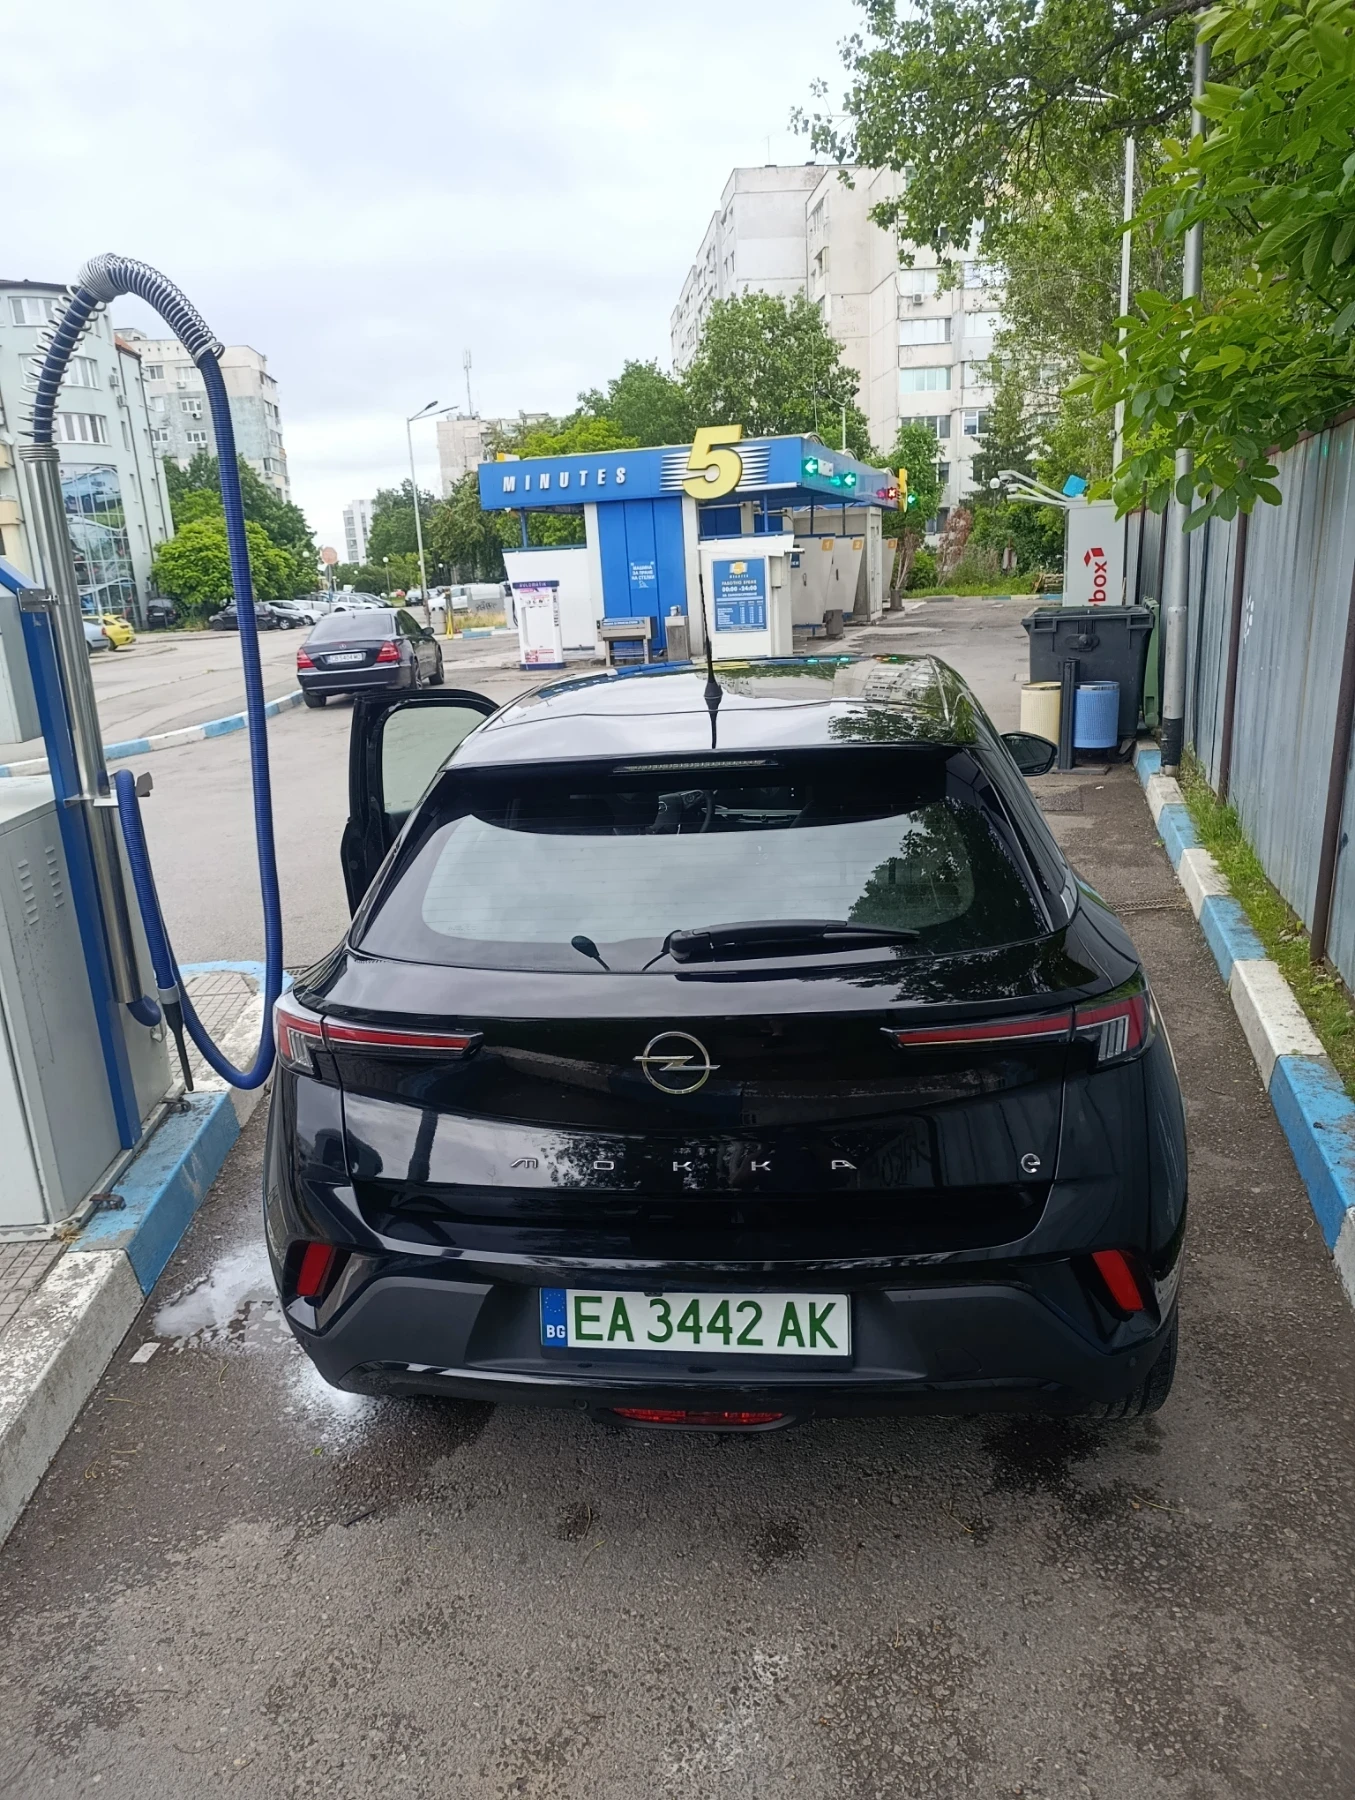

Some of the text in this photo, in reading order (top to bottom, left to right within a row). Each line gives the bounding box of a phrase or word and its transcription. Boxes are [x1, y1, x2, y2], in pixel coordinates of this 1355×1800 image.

[502, 466, 627, 492] MINUTES
[682, 424, 743, 499] 5
[1088, 561, 1107, 606] box
[510, 1157, 857, 1171] MOKKA
[546, 1296, 838, 1349] BG EA 3442 AK
